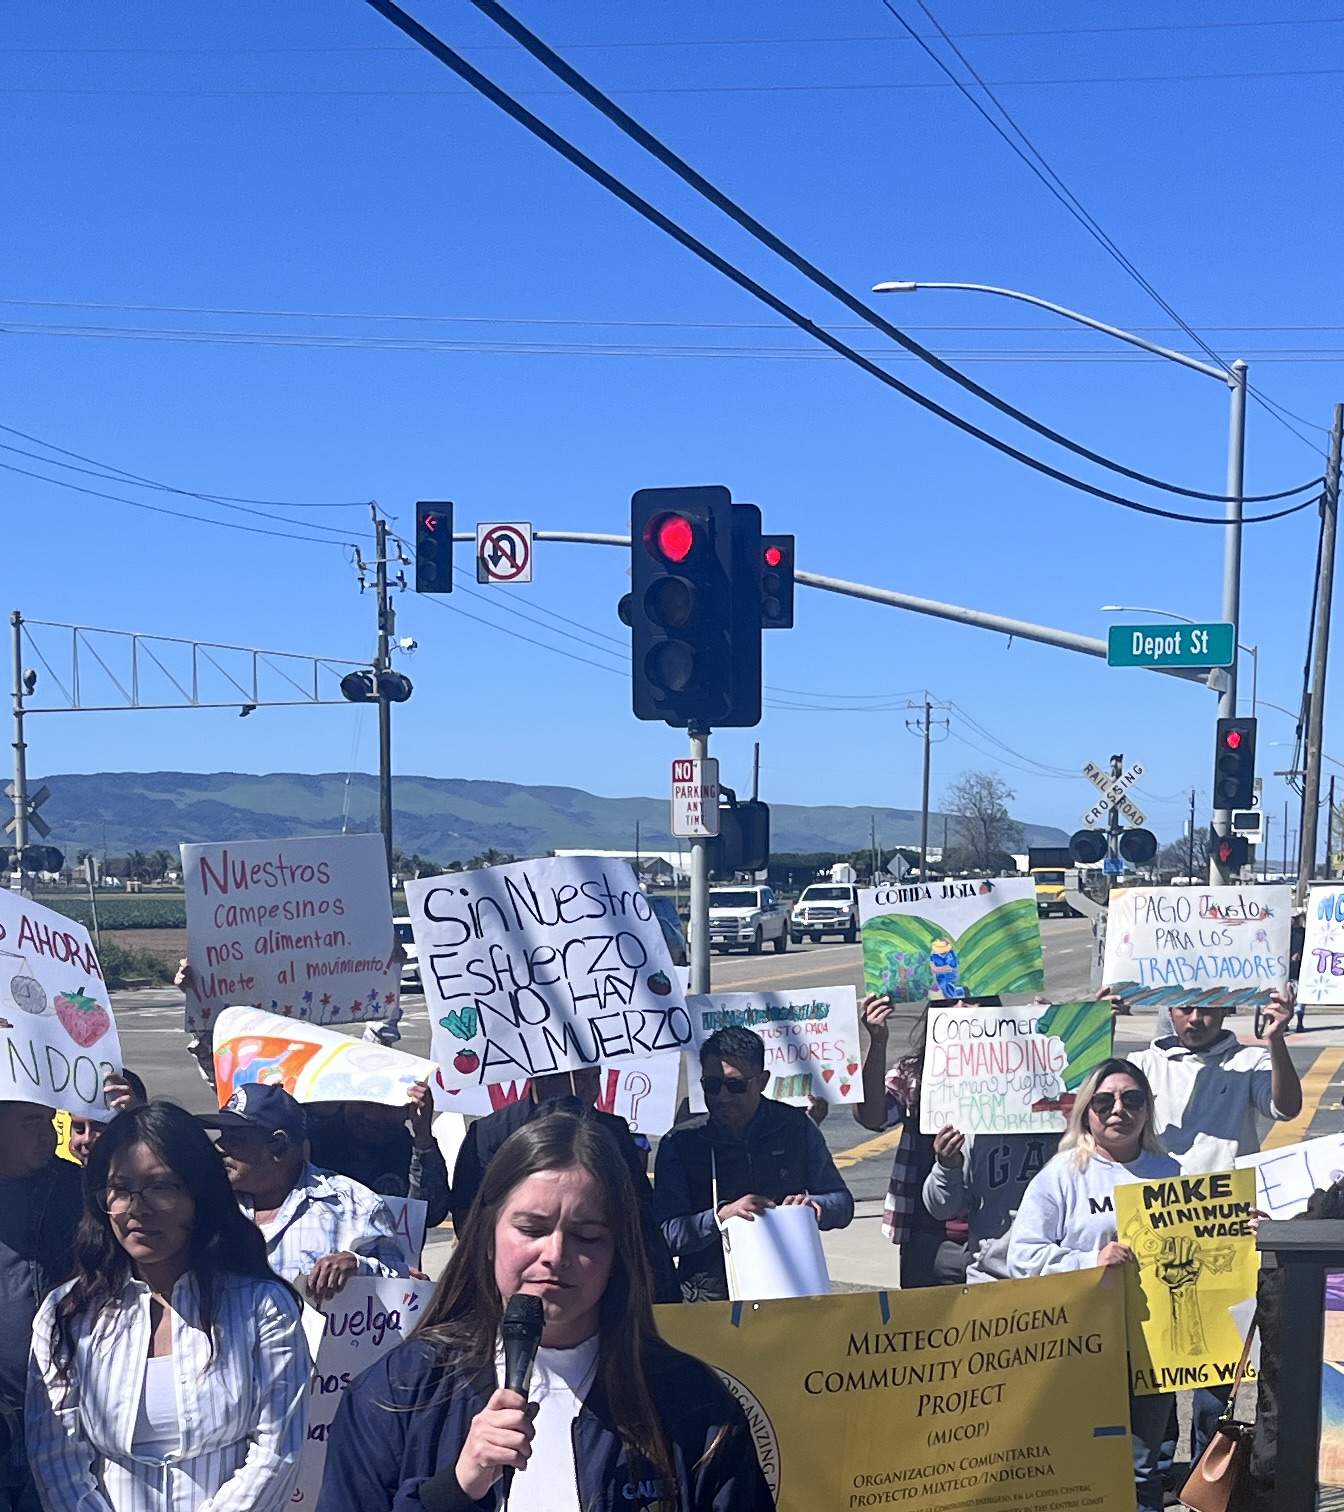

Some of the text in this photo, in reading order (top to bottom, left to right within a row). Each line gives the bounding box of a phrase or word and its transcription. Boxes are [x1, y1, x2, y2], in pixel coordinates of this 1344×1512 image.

[1132, 629, 1209, 660] Depot St
[674, 762, 691, 780] NO
[675, 785, 716, 799] PARKING
[687, 801, 705, 812] ANY
[1083, 763, 1144, 826] RAIL ROAD
[1085, 764, 1143, 825] CROSSING
[686, 815, 704, 826] TIME
[200, 850, 331, 896] Nuestros
[423, 872, 653, 948] Sin Nuestro
[1134, 895, 1191, 925] PAGO
[18, 914, 104, 980] AHORA
[206, 929, 352, 967] nos alimentan.
[1156, 927, 1233, 951] PARA LOS
[277, 961, 296, 986] al
[1132, 955, 1288, 986] TRABAJADORES
[475, 969, 638, 1037] NO HAY
[479, 1006, 692, 1085] ALMUERZO
[765, 1040, 845, 1066] JADORES
[932, 1036, 1064, 1077] DEMANDING
[958, 1094, 1006, 1120] FARM
[1142, 1174, 1233, 1210] MAKE
[1149, 1202, 1251, 1229] MINIMUM
[1194, 1223, 1251, 1238] WAGE
[804, 1333, 1103, 1395] COMMUNITY ORGANIZING
[1134, 1369, 1150, 1391] A
[1153, 1362, 1209, 1389] LIVING
[916, 1382, 1006, 1417] PROJECT
[927, 1420, 990, 1447] (MICOP)
[959, 1445, 1051, 1471] COMUNITARIA
[849, 1486, 918, 1508] PROYECTO
